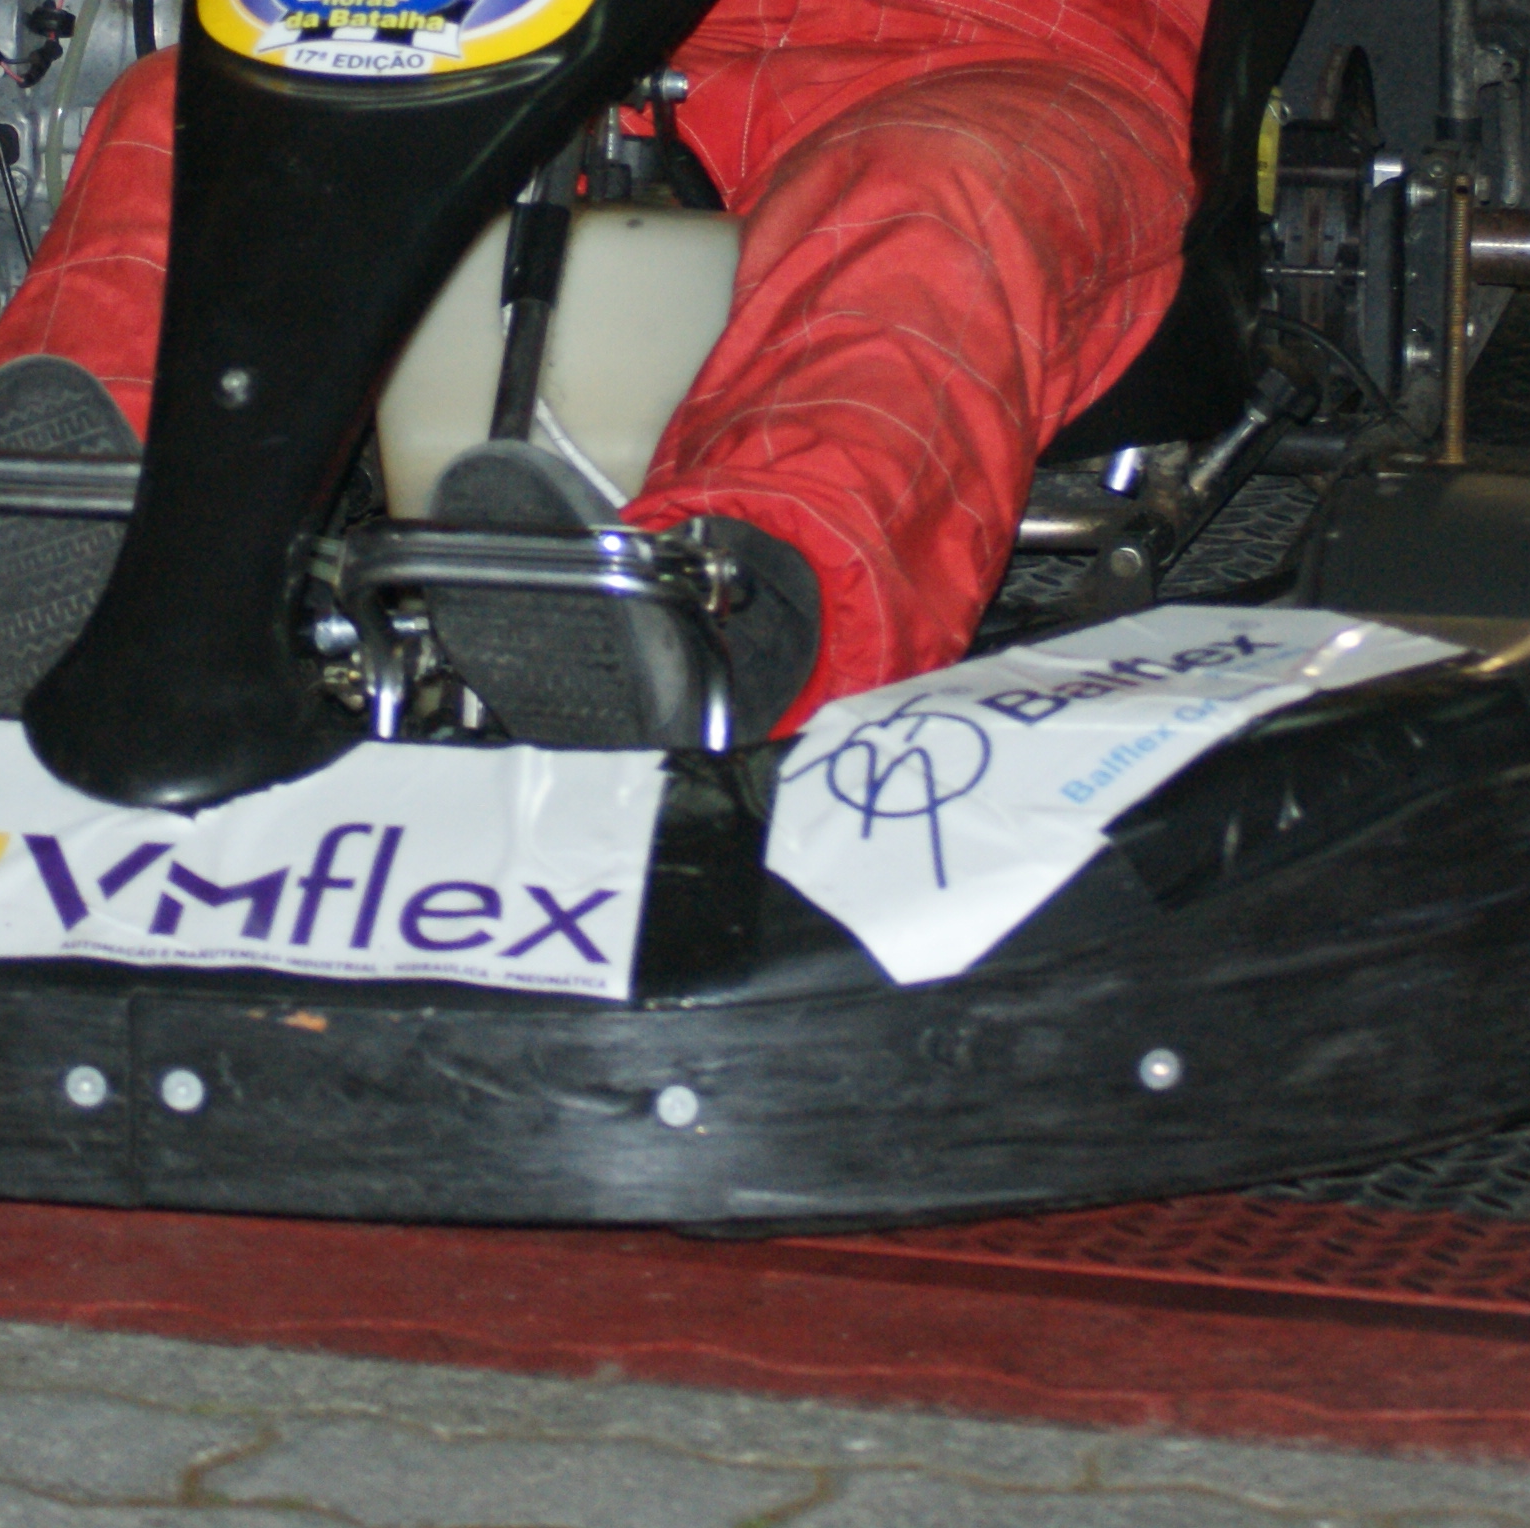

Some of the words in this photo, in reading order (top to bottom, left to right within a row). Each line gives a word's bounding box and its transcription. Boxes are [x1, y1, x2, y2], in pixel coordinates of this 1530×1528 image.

[285, 11, 320, 29] da
[327, 8, 446, 32] Batalha
[331, 49, 425, 73] EDIÇÃO
[1059, 726, 1174, 805] Balflex
